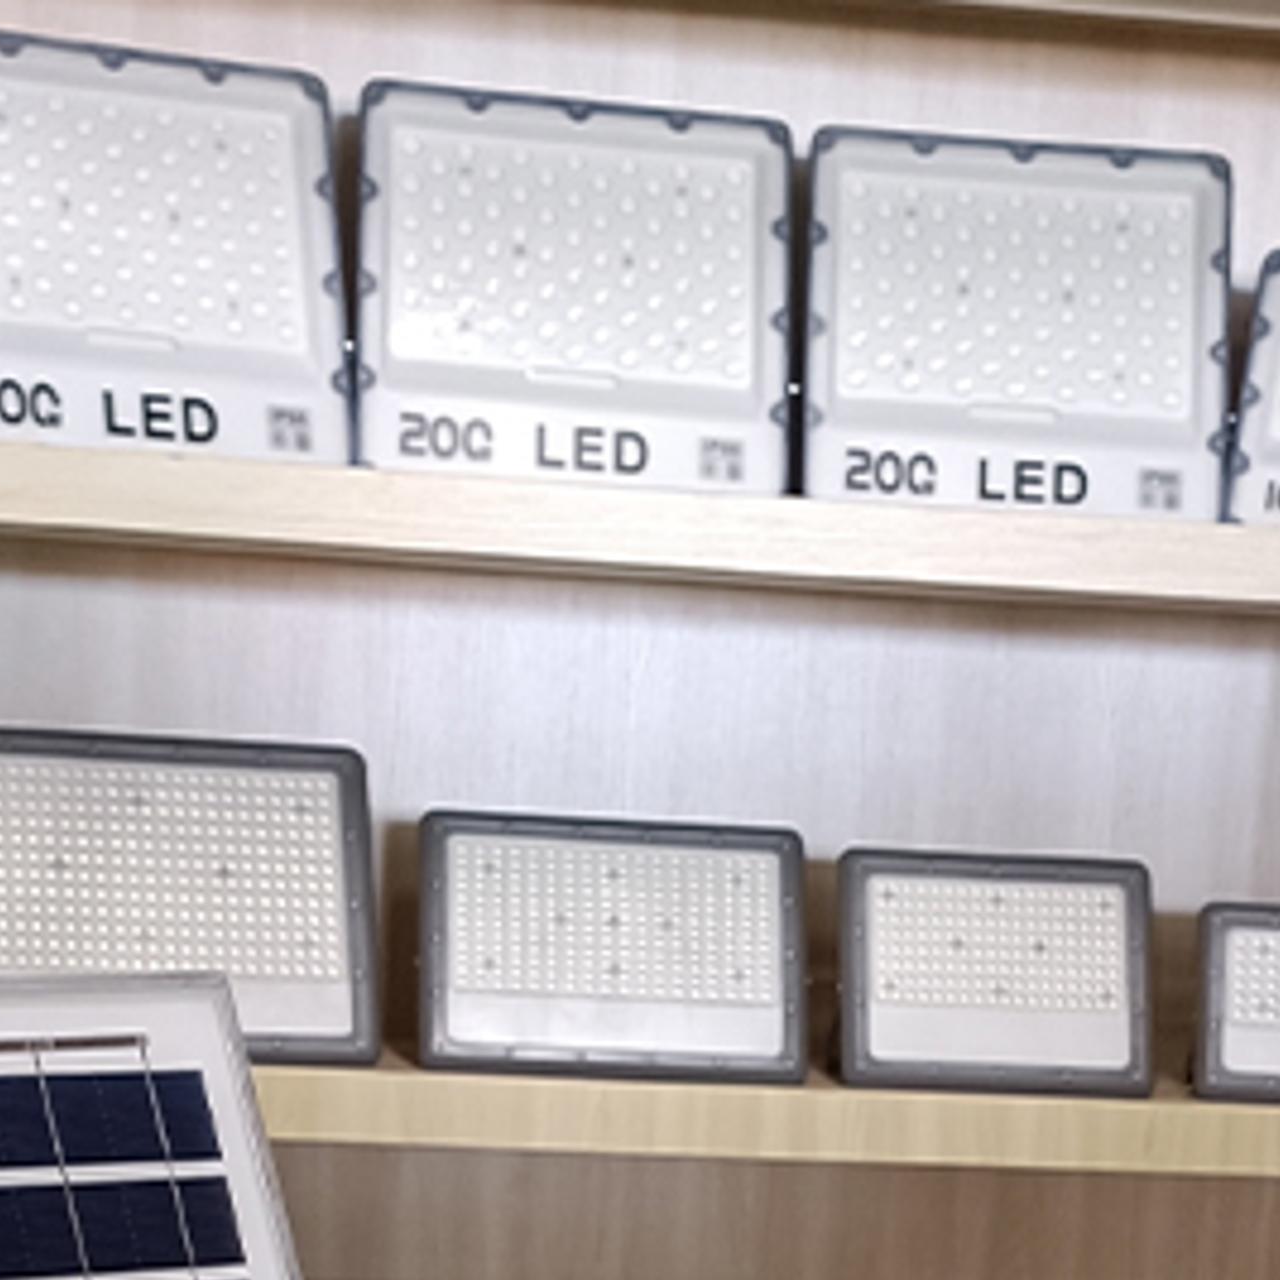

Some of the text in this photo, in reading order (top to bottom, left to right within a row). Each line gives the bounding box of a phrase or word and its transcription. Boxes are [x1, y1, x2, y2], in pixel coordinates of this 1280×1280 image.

[102, 390, 219, 444] LED
[536, 424, 650, 476] LED
[978, 458, 1089, 505] LED
